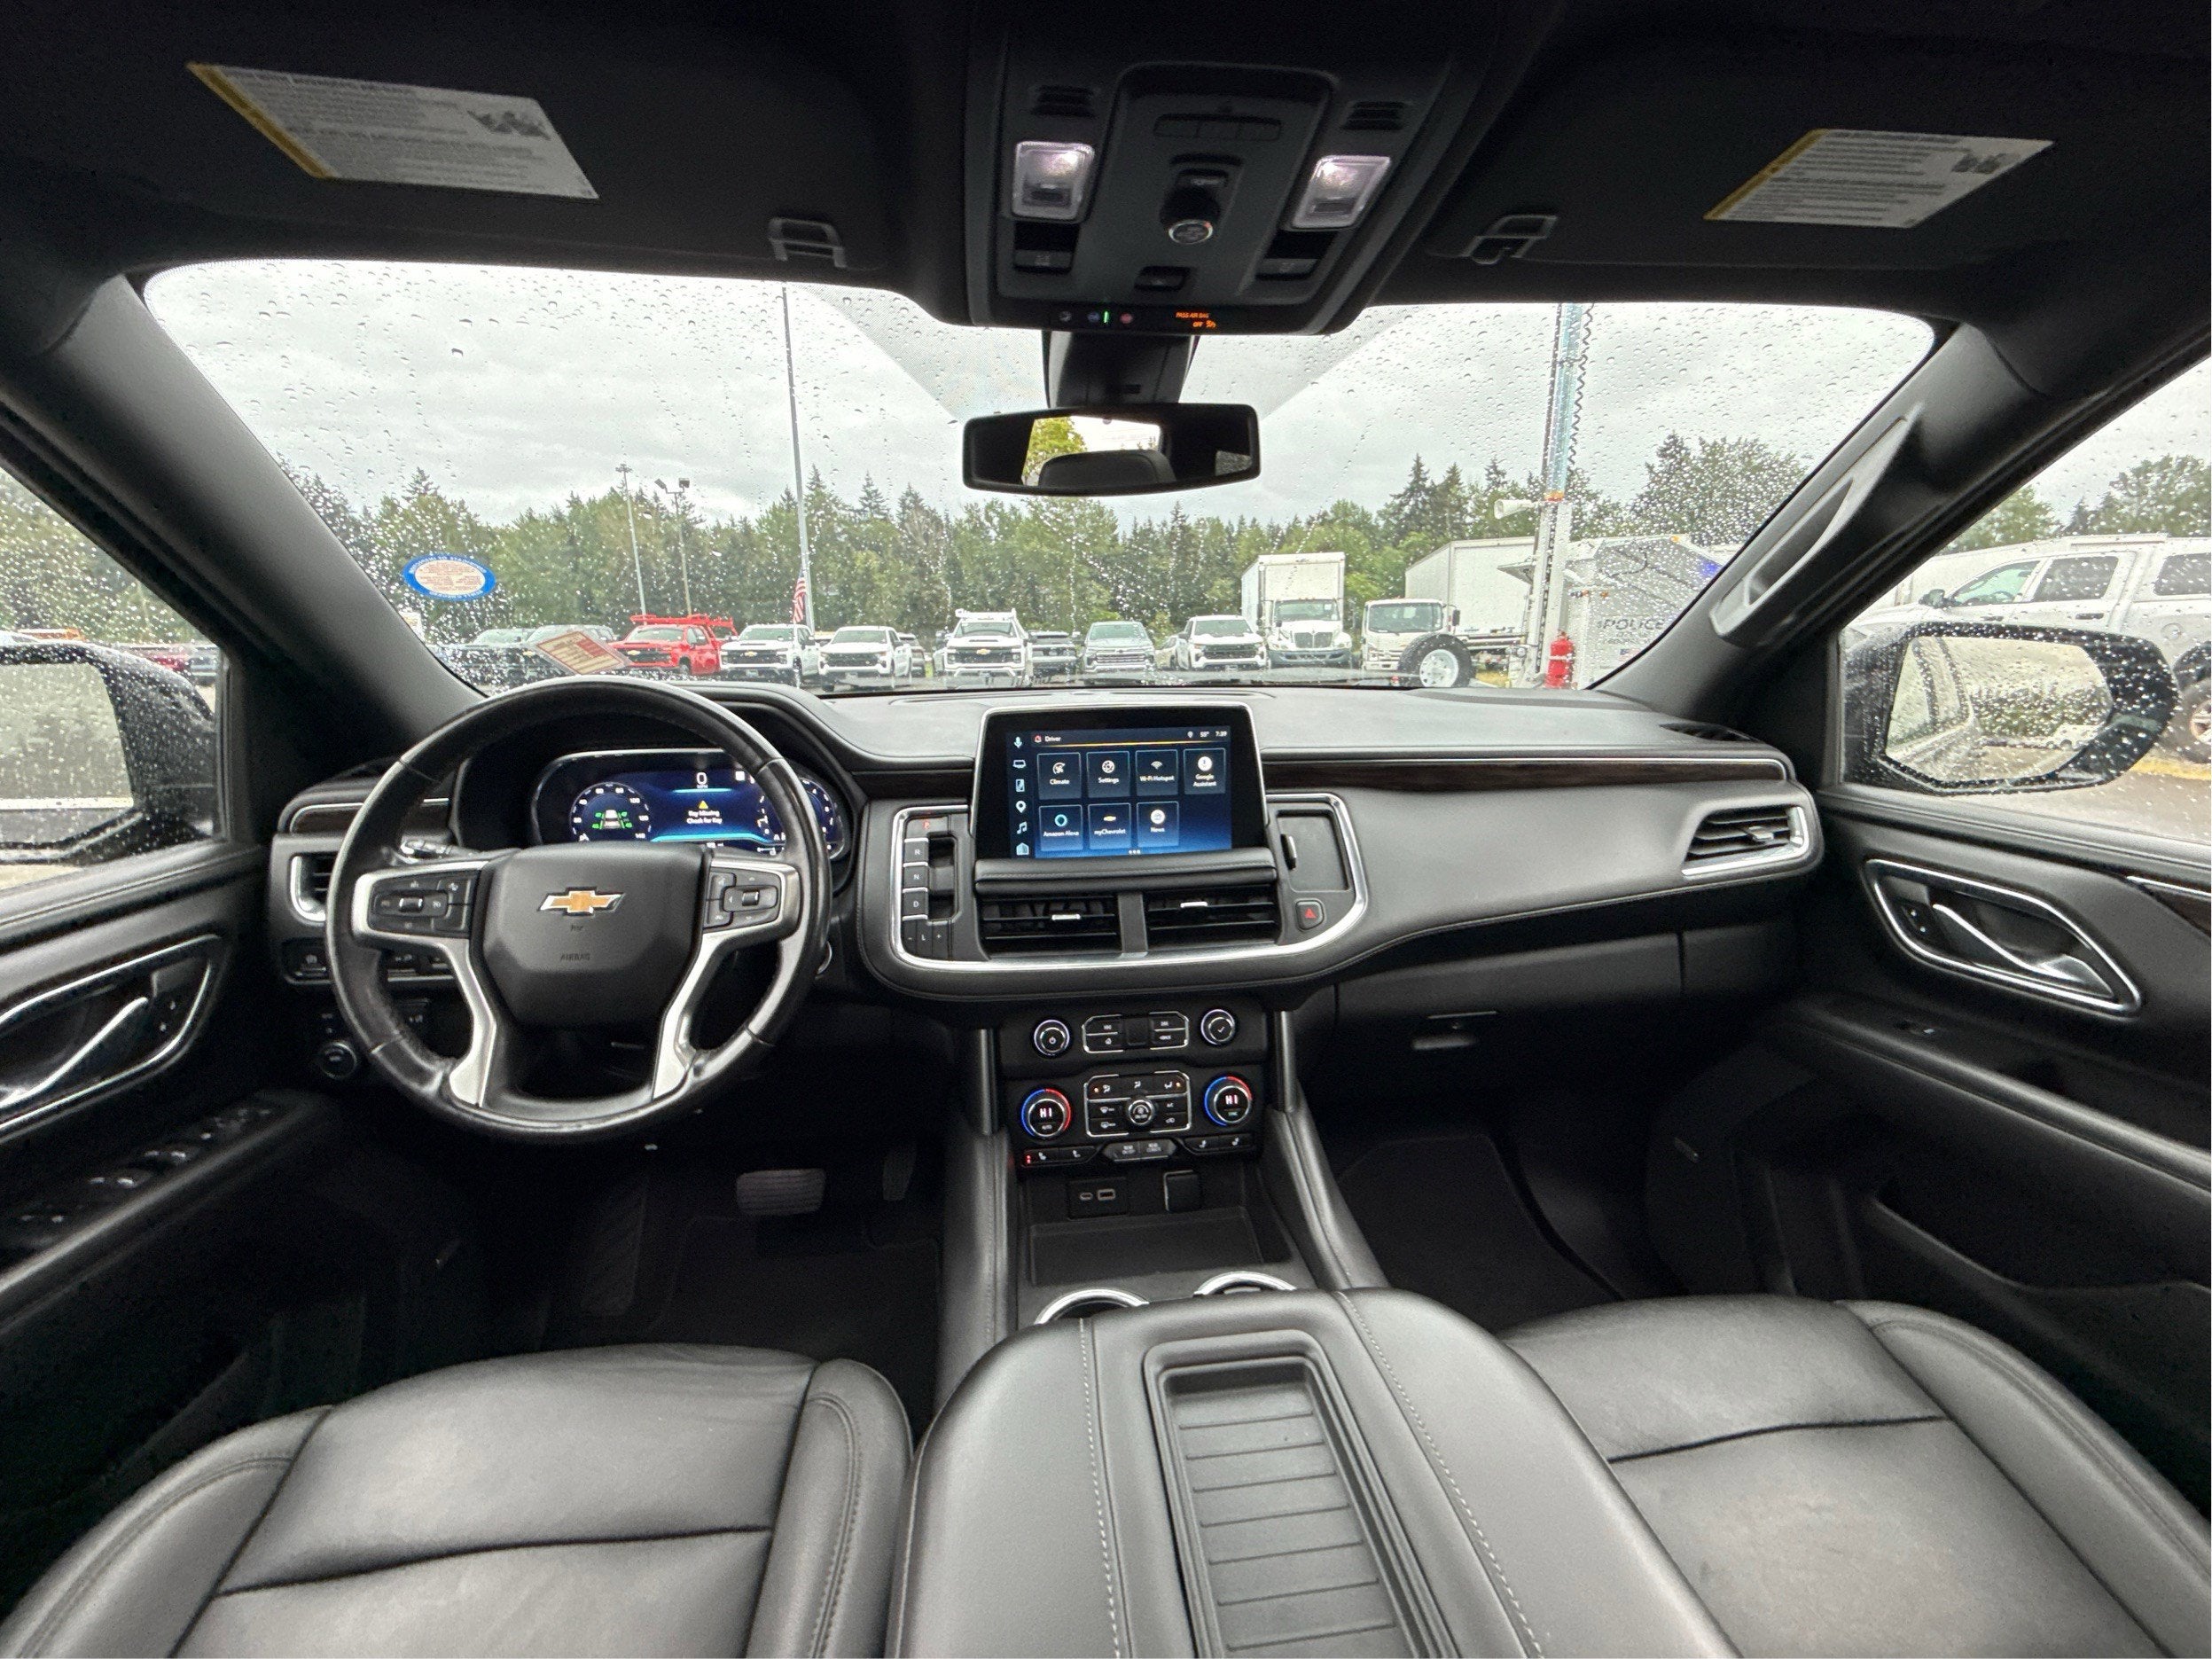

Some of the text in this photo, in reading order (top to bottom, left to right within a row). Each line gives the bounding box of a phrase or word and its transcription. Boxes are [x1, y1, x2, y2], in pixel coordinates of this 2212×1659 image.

[1603, 618, 1665, 630] POLICE
[696, 771, 707, 785] 0
[1224, 1094, 1239, 1105] HI
[1039, 1107, 1052, 1118] HI
